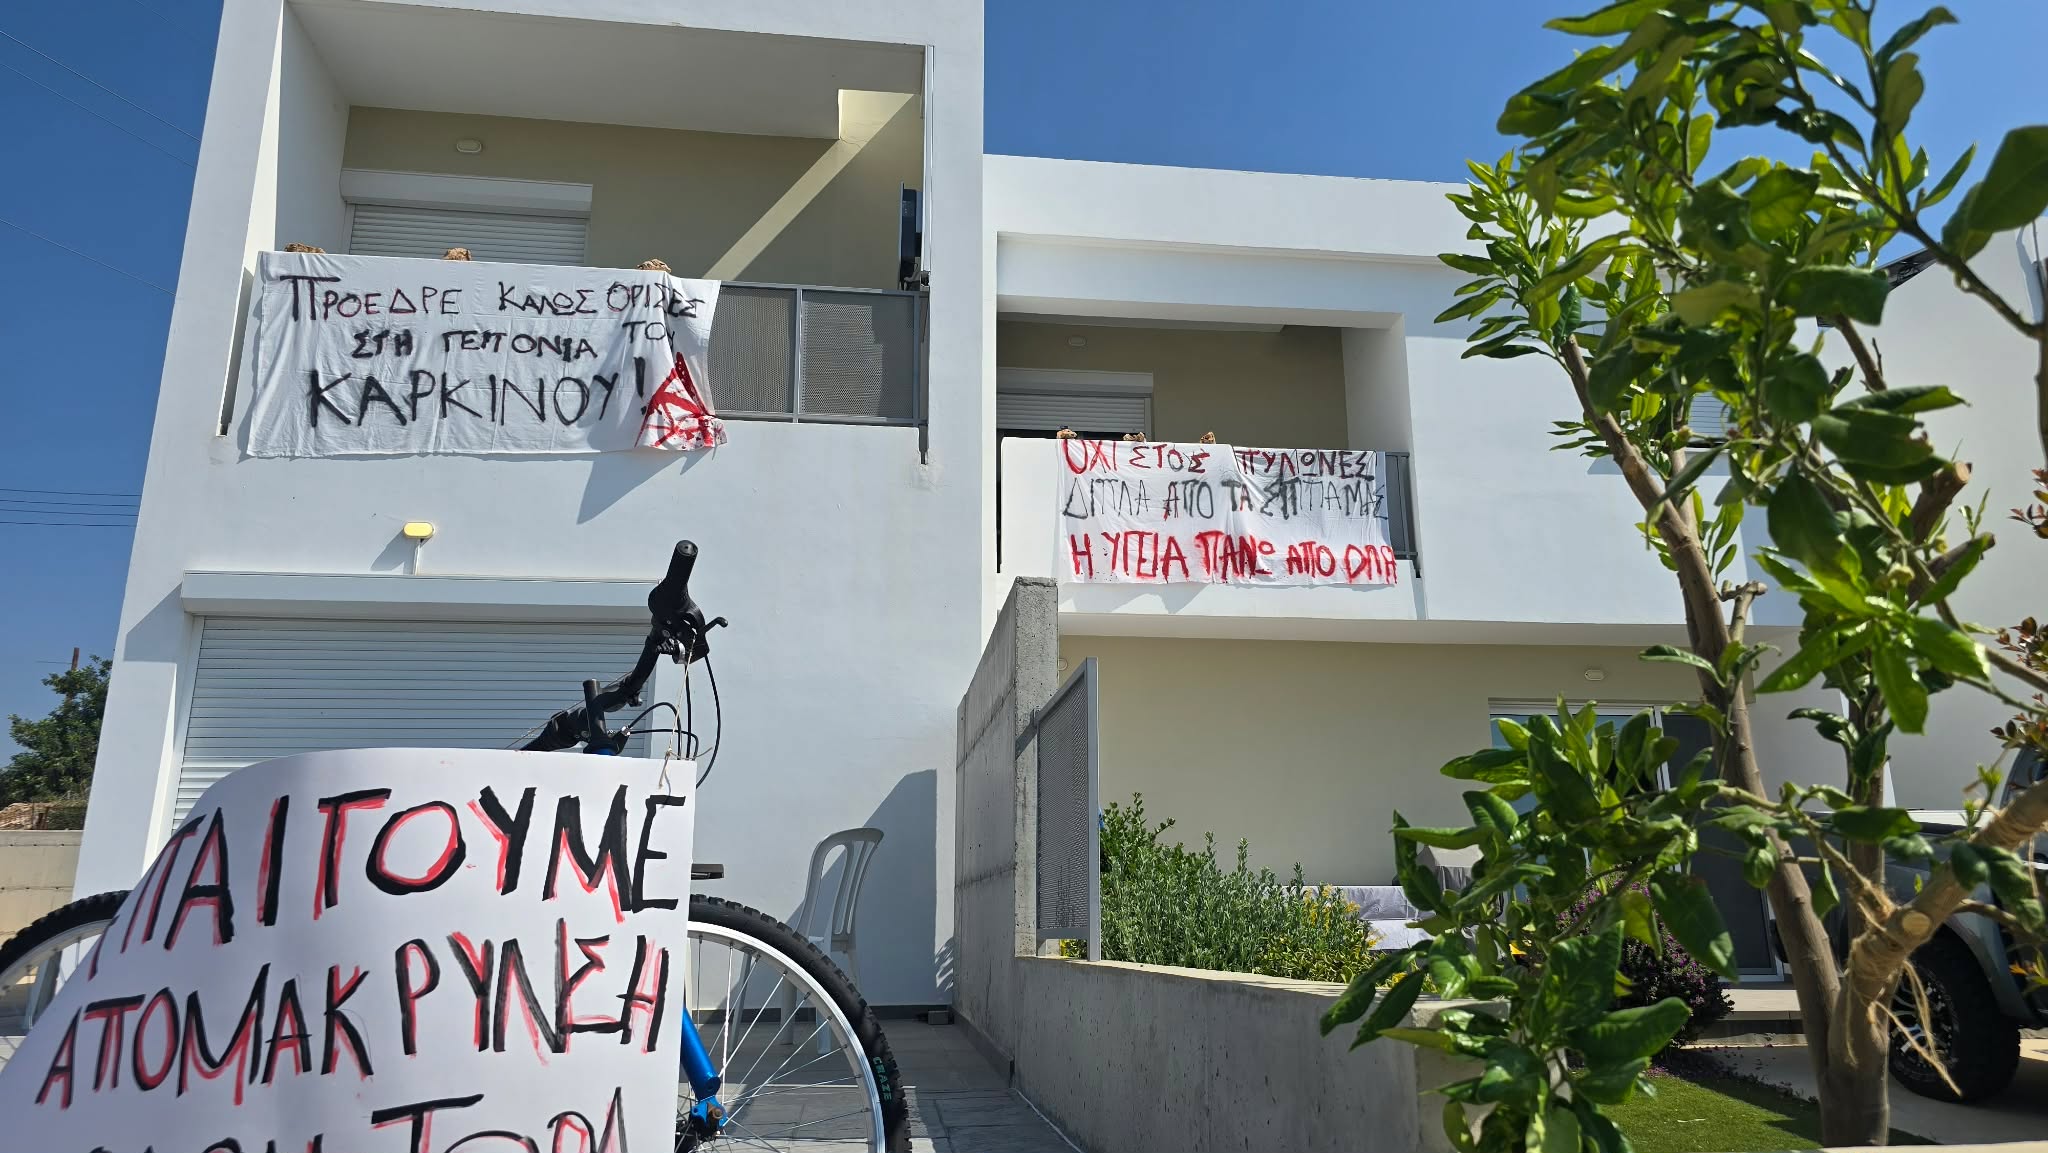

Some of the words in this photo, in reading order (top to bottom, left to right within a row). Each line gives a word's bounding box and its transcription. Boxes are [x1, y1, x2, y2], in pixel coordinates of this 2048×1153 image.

[280, 275, 462, 321] ΠΡΟΕΔΡΕ
[498, 281, 597, 316] ΚΑΛΩΣ
[352, 329, 412, 358] ΣΤΗ
[1062, 439, 1117, 474] ΟΧΙ
[1062, 477, 1150, 519] ΔΙΠΛΑ
[1163, 479, 1214, 521] ΑΠΟ
[1070, 533, 1093, 579] Η
[1101, 531, 1189, 583] ΥΓΕΙΑ
[1286, 541, 1336, 578] ΑΠΟ
